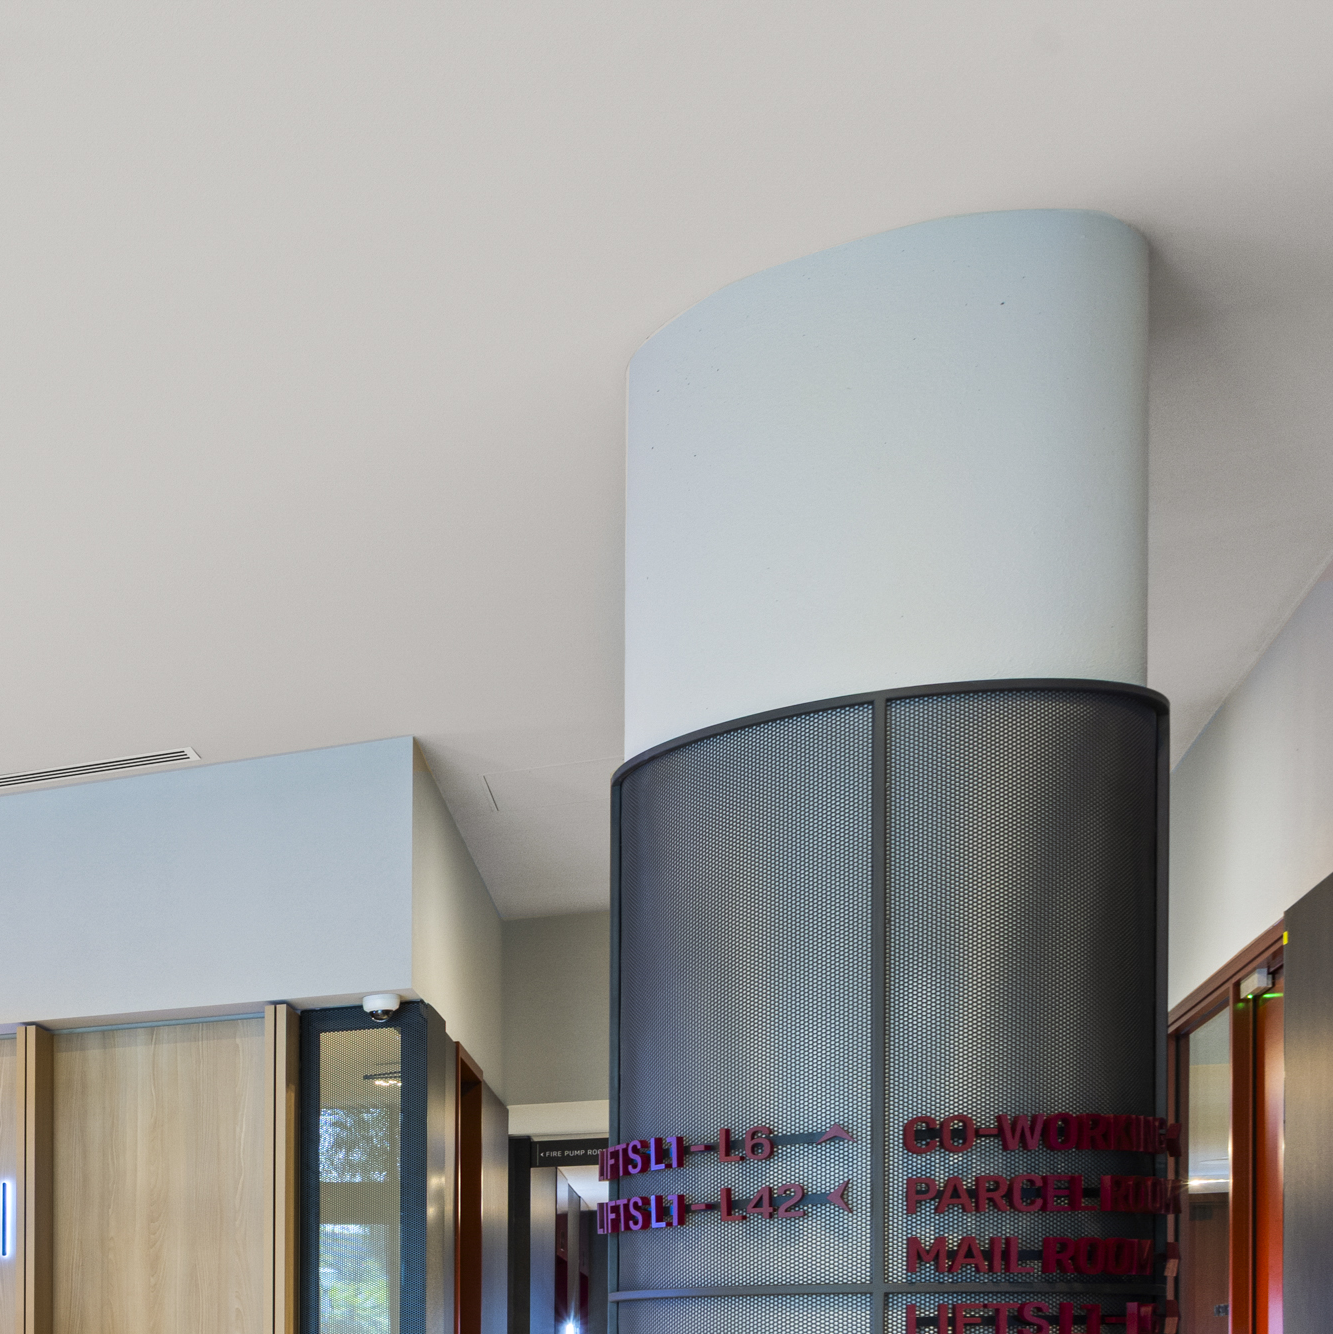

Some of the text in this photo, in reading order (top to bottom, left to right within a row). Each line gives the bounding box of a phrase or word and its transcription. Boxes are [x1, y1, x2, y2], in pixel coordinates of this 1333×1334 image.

[564, 1149, 585, 1157] PUMP
[598, 1139, 649, 1182] LIFTS
[719, 1126, 774, 1163] L6
[597, 1196, 650, 1234] LIFTS
[720, 1183, 806, 1222] L42
[906, 1174, 1098, 1214] PARCEL
[907, 1235, 1154, 1275] MAIL ROOM
